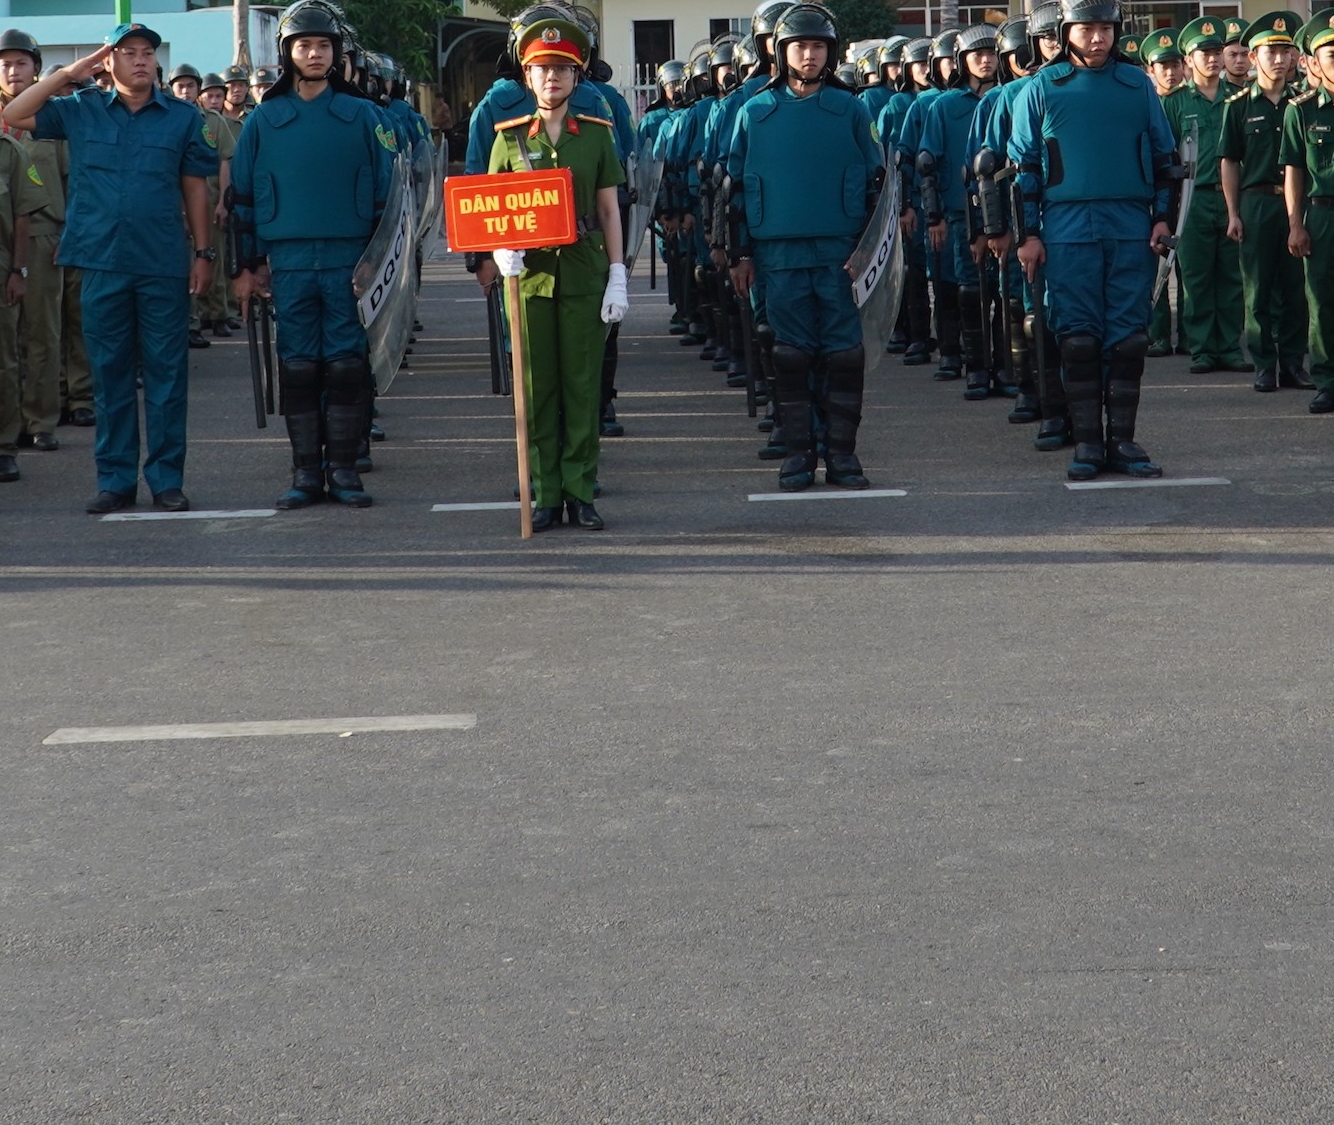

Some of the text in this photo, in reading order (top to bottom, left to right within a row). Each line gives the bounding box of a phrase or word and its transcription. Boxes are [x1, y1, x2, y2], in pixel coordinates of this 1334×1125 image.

[460, 188, 558, 214] DÂN QUÂN
[484, 211, 537, 235] TỰ VỆ
